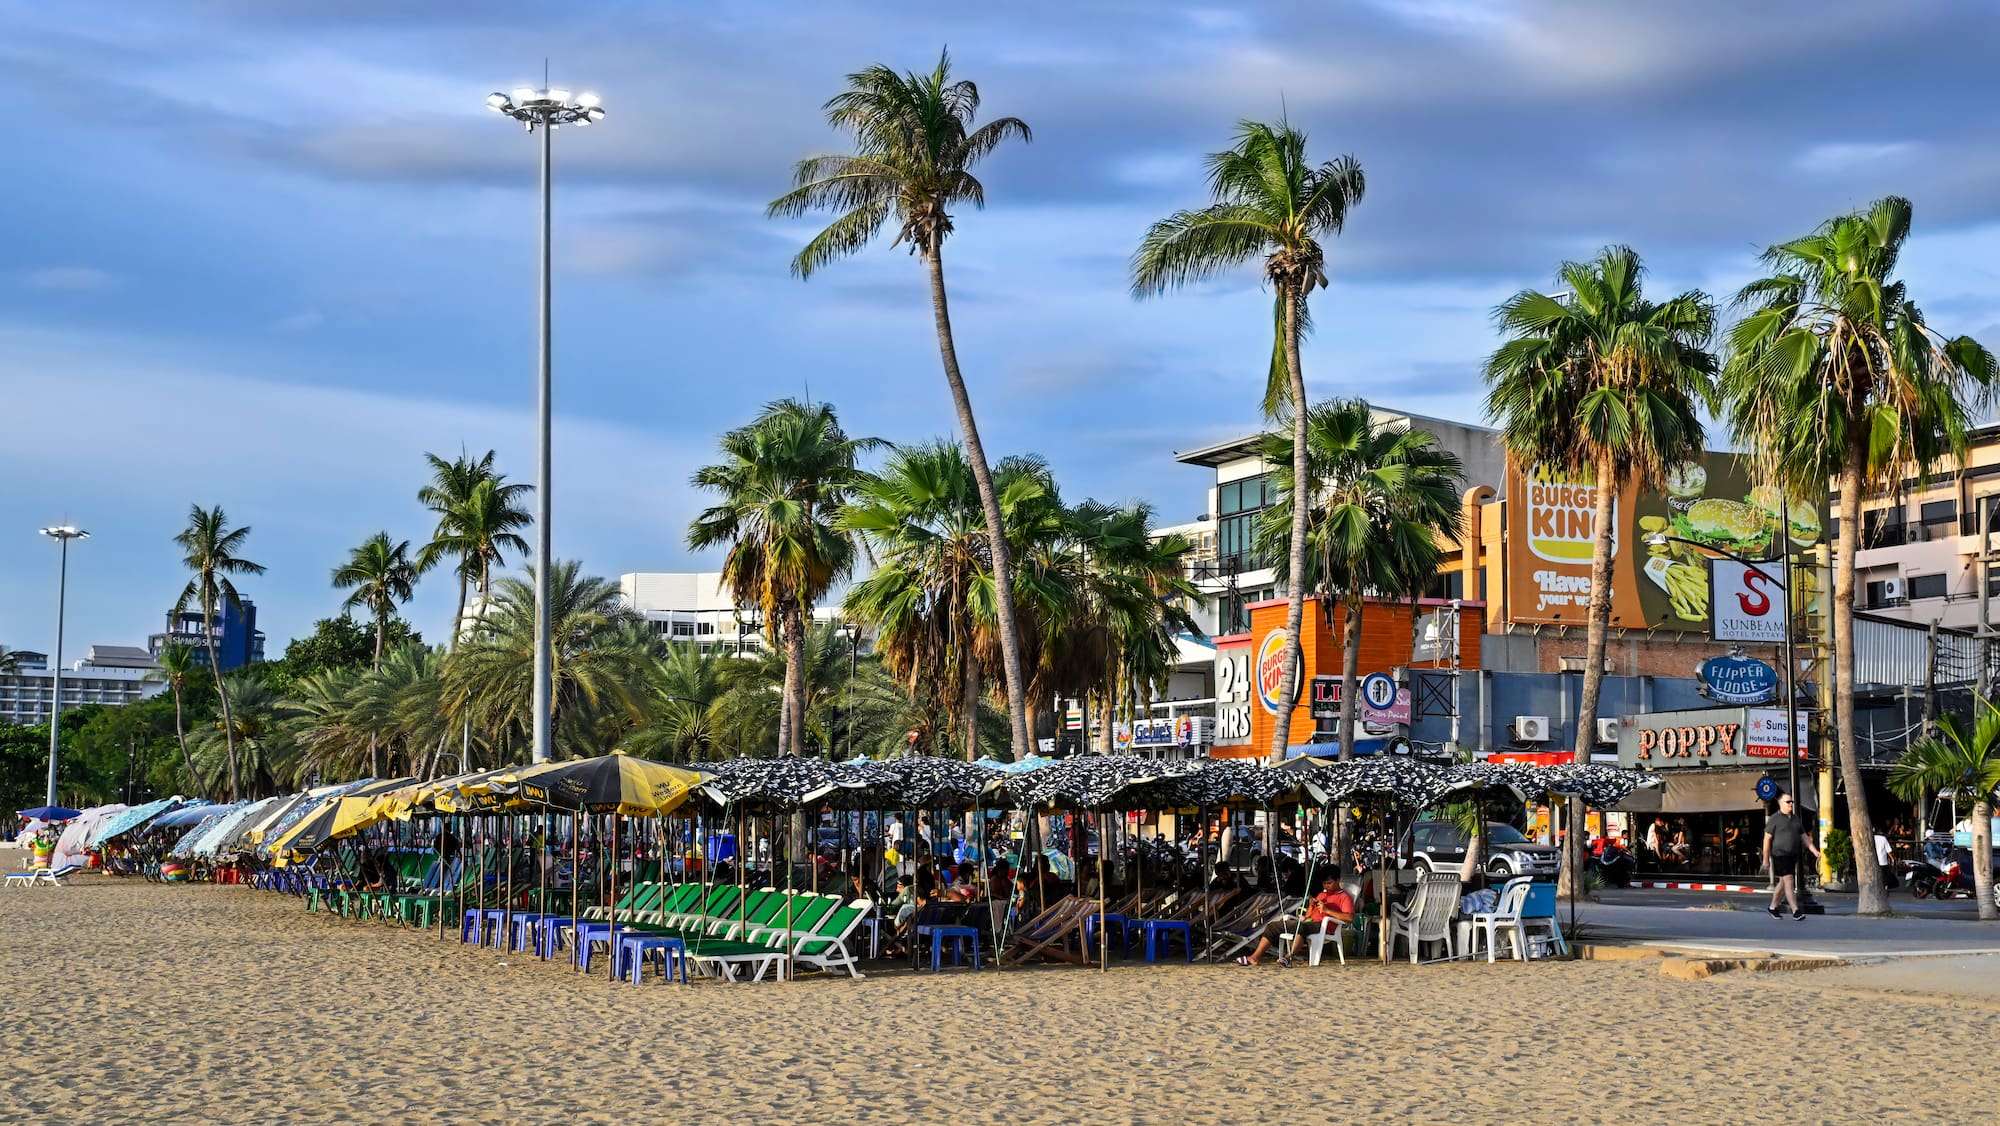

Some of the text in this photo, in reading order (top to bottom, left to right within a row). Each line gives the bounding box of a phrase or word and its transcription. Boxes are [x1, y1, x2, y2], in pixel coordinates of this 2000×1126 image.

[1531, 485, 1598, 510] BURGE
[1531, 507, 1597, 540] KIN
[1532, 570, 1592, 594] Have
[1536, 593, 1573, 612] your
[1722, 618, 1785, 632] SUNBEAM
[1722, 630, 1785, 639] HOTEL PATTAYA
[1219, 655, 1251, 704] 24
[1263, 668, 1283, 697] KIN
[1711, 665, 1764, 681] FLIPPER
[1716, 679, 1758, 694] LODGE
[1219, 706, 1251, 739] HRS
[1638, 723, 1741, 760] POPPY
[1749, 735, 1765, 743] Hotel
[1749, 746, 1790, 758] ALL DAY CA
